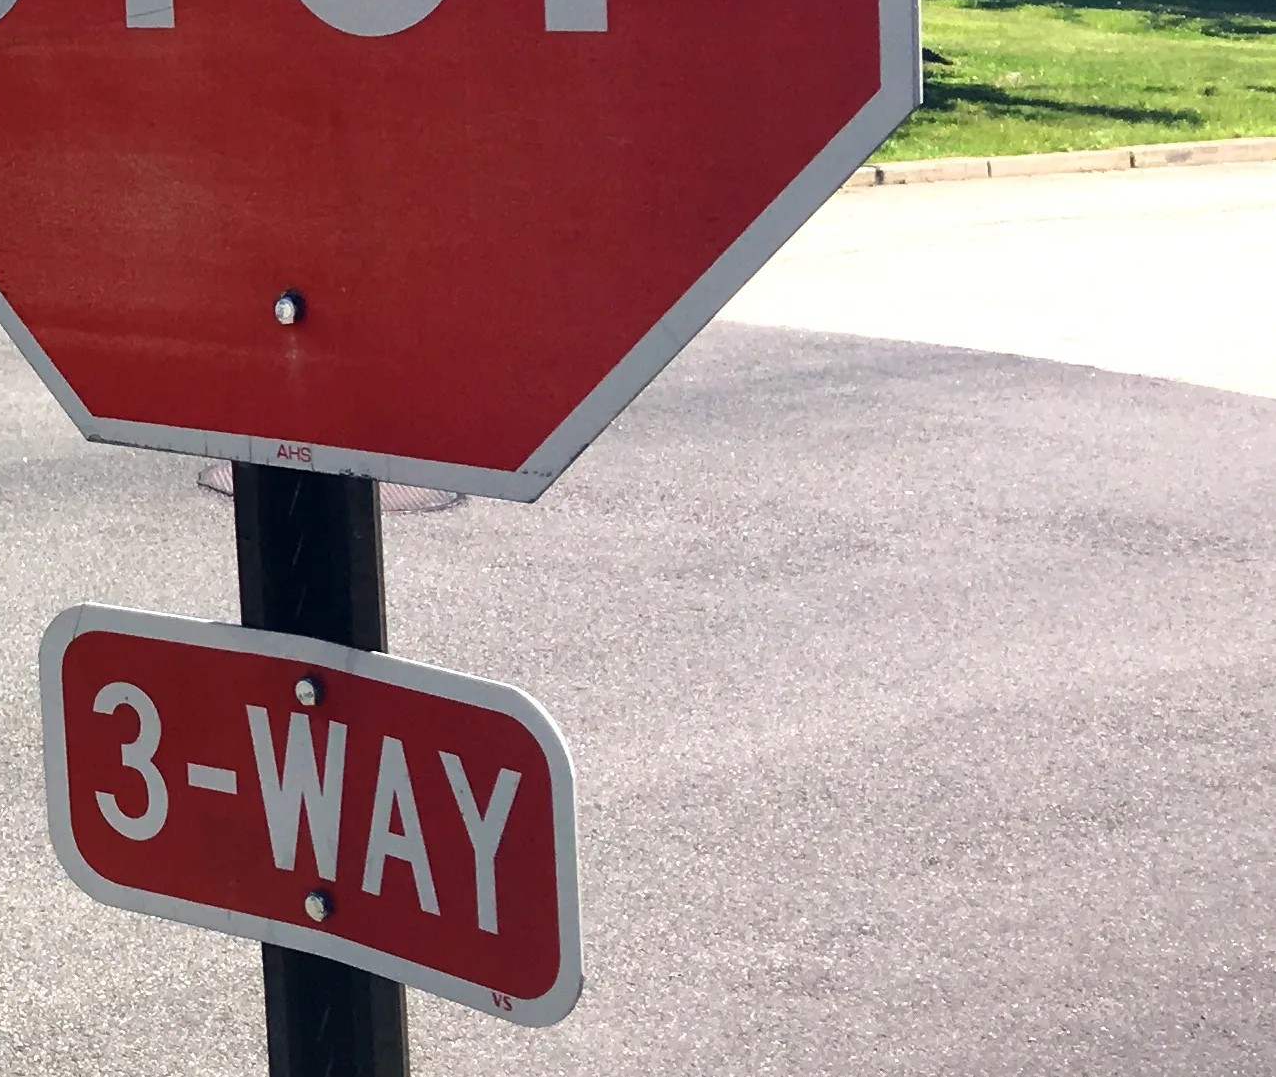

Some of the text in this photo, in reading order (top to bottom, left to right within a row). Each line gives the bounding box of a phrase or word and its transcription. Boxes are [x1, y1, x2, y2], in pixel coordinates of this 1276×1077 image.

[277, 444, 312, 462] AHS
[93, 682, 522, 935] 3-WAY
[492, 992, 513, 1012] VS
